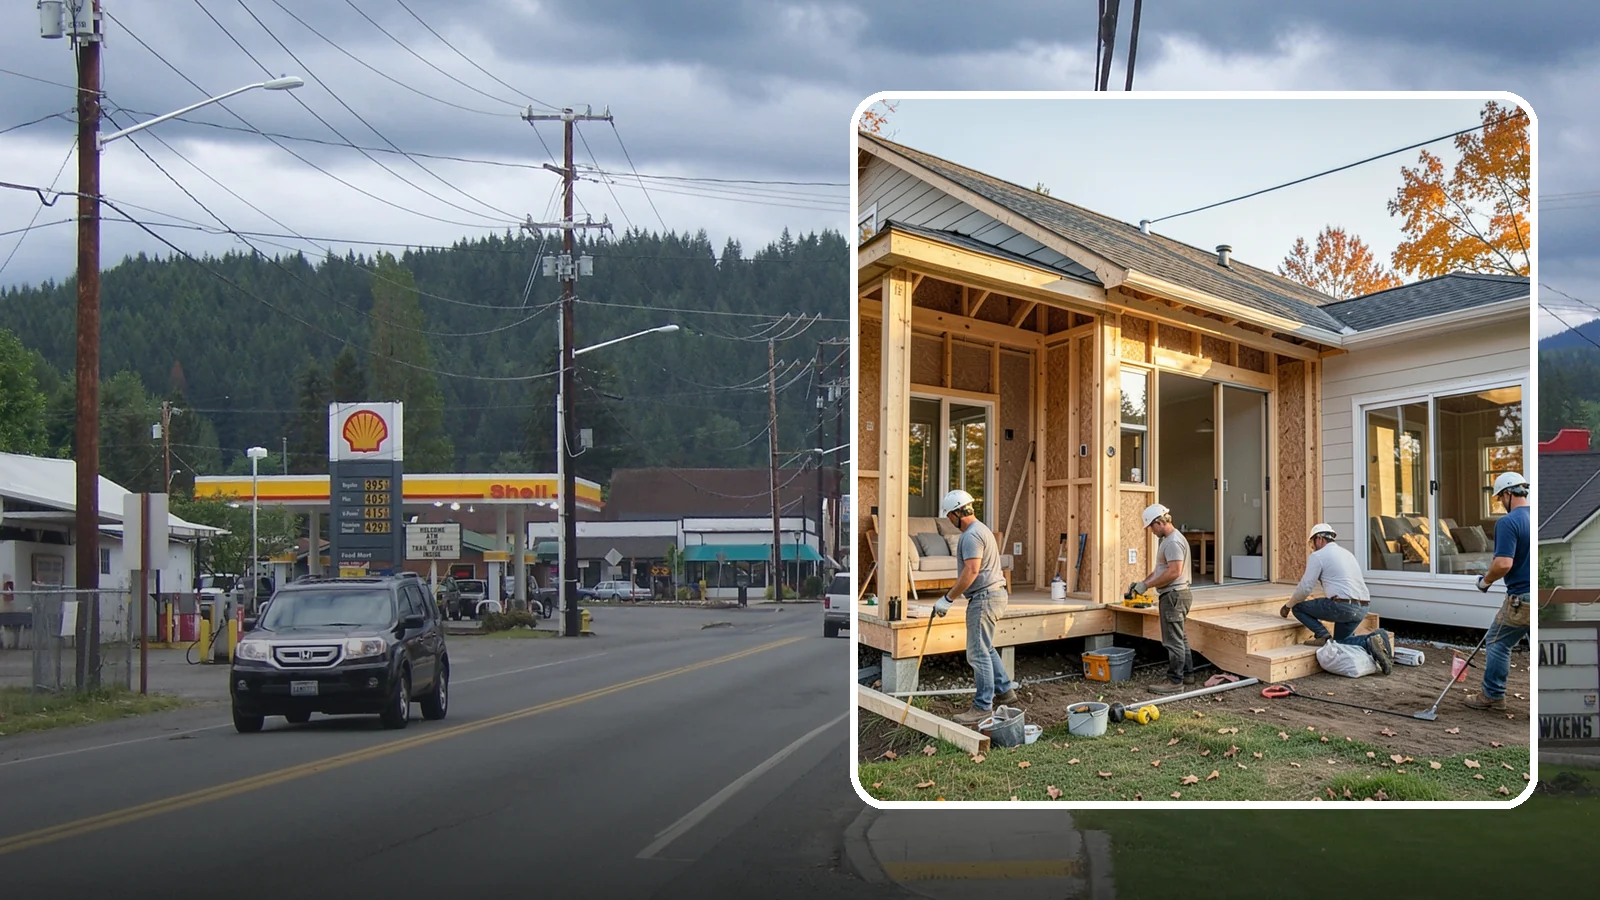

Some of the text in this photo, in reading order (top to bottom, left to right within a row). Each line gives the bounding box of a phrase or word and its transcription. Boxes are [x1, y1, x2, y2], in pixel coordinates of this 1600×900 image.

[366, 480, 383, 490] 395
[490, 484, 548, 499] Shell
[366, 494, 383, 504] 405
[366, 508, 383, 518] 415
[366, 522, 383, 532] 429
